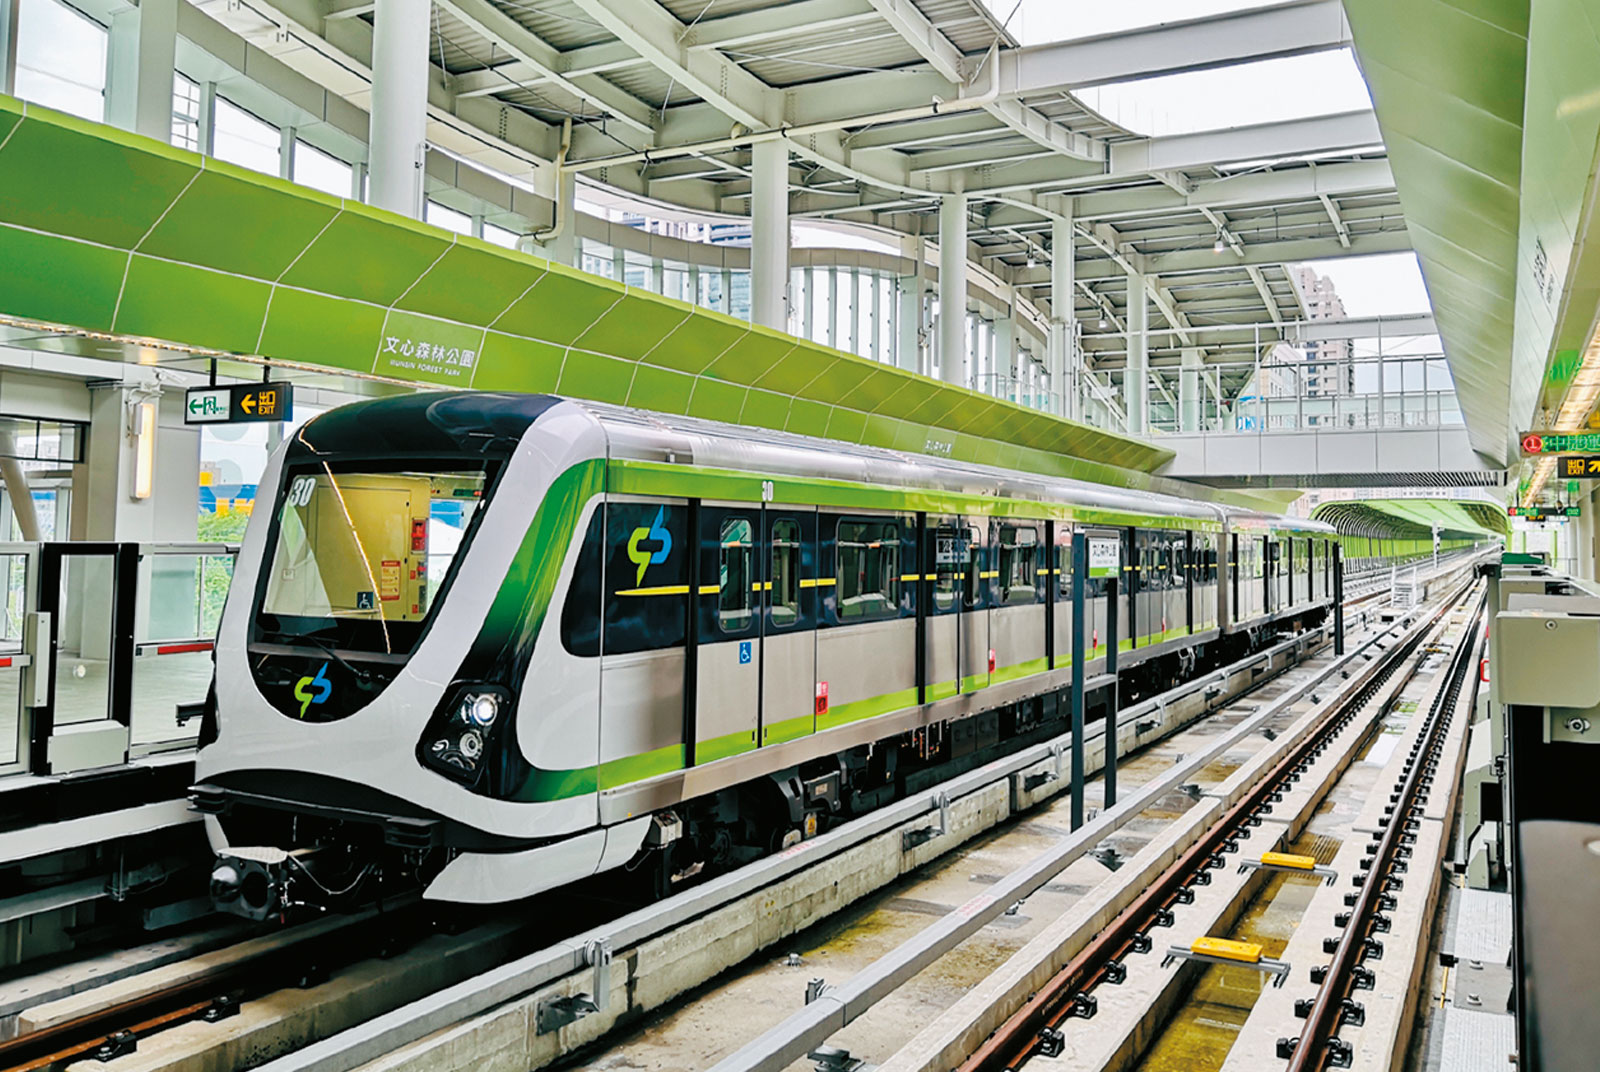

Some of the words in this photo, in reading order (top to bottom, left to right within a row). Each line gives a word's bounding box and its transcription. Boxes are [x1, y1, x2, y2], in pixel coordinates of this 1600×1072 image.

[383, 336, 475, 368] 文心森林公園
[418, 363, 442, 373] FOREST
[444, 368, 461, 376] PARK
[258, 390, 276, 406] 出口
[258, 405, 275, 415] EXIT
[1567, 459, 1585, 469] 出口
[1567, 468, 1584, 476] EXIT
[290, 478, 316, 507] 30
[762, 480, 774, 501] 30
